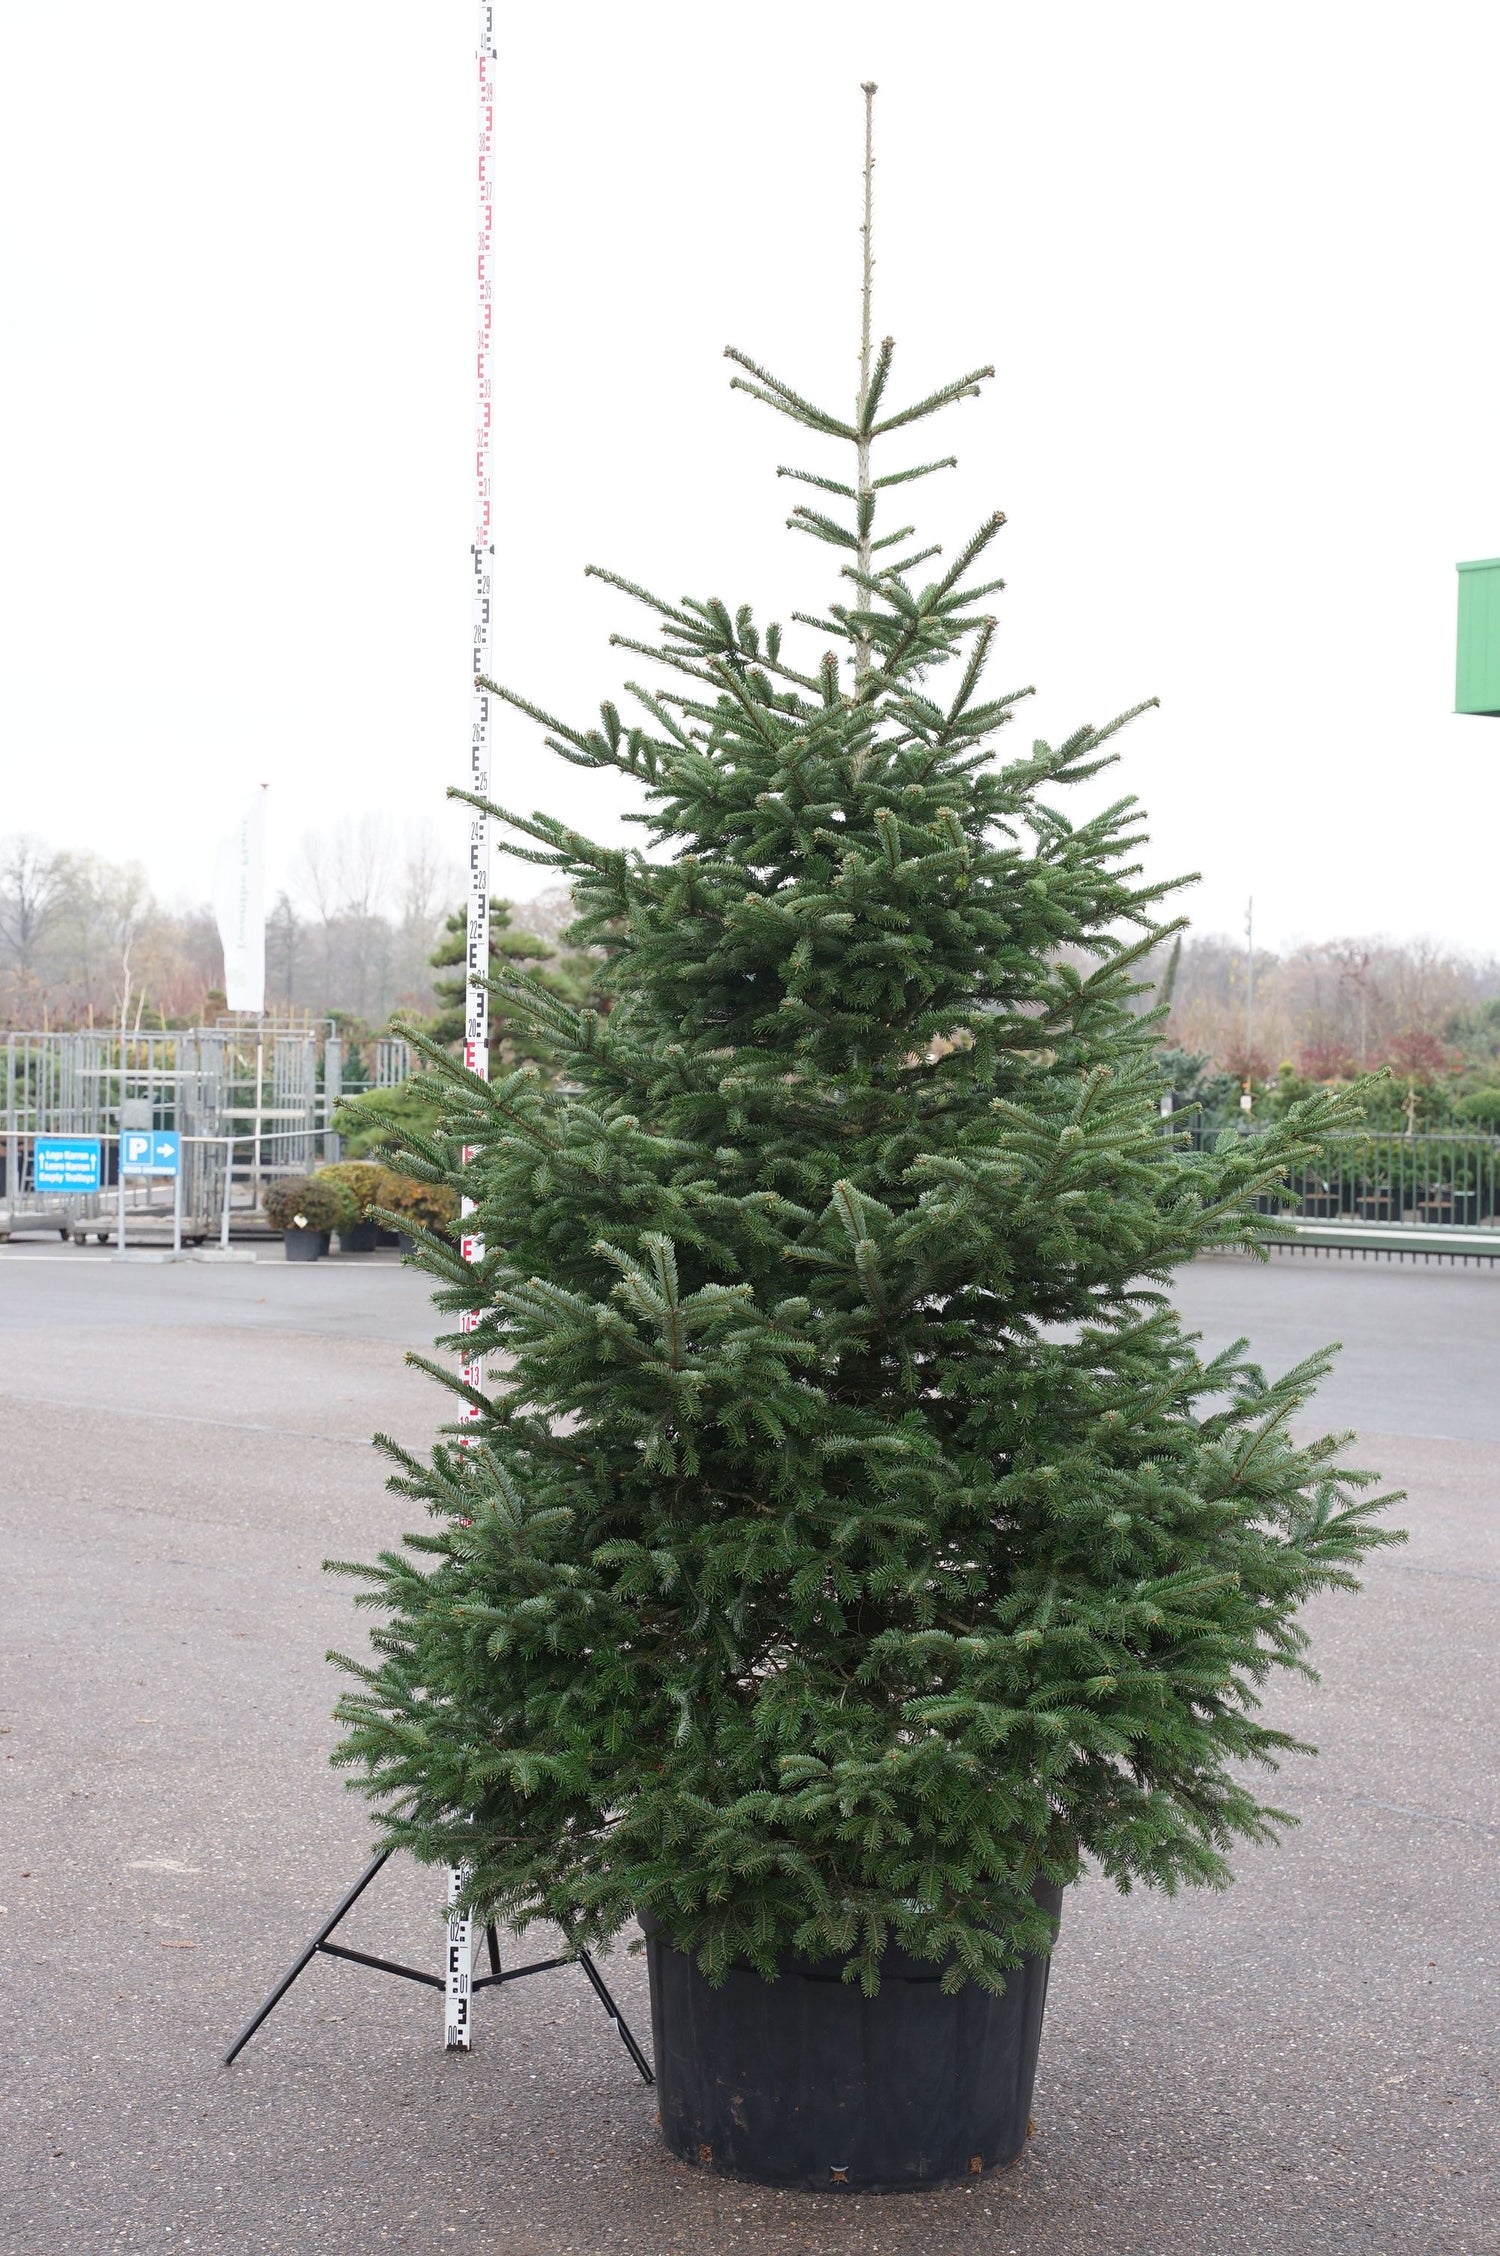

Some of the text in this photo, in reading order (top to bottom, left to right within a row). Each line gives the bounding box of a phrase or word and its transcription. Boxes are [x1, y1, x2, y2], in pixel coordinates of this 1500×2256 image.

[473, 625, 481, 643] 28
[472, 723, 480, 742] 26
[480, 772, 488, 790] 25
[478, 871, 486, 889] 23
[469, 920, 477, 939] 22
[468, 1018, 476, 1037] 20
[129, 1137, 148, 1161] P
[39, 1172, 96, 1184] Empty Trolleys
[470, 1366, 479, 1386] 13
[450, 1922, 459, 1942] 02
[459, 1974, 468, 1993] 01
[448, 2025, 457, 2045] 00
